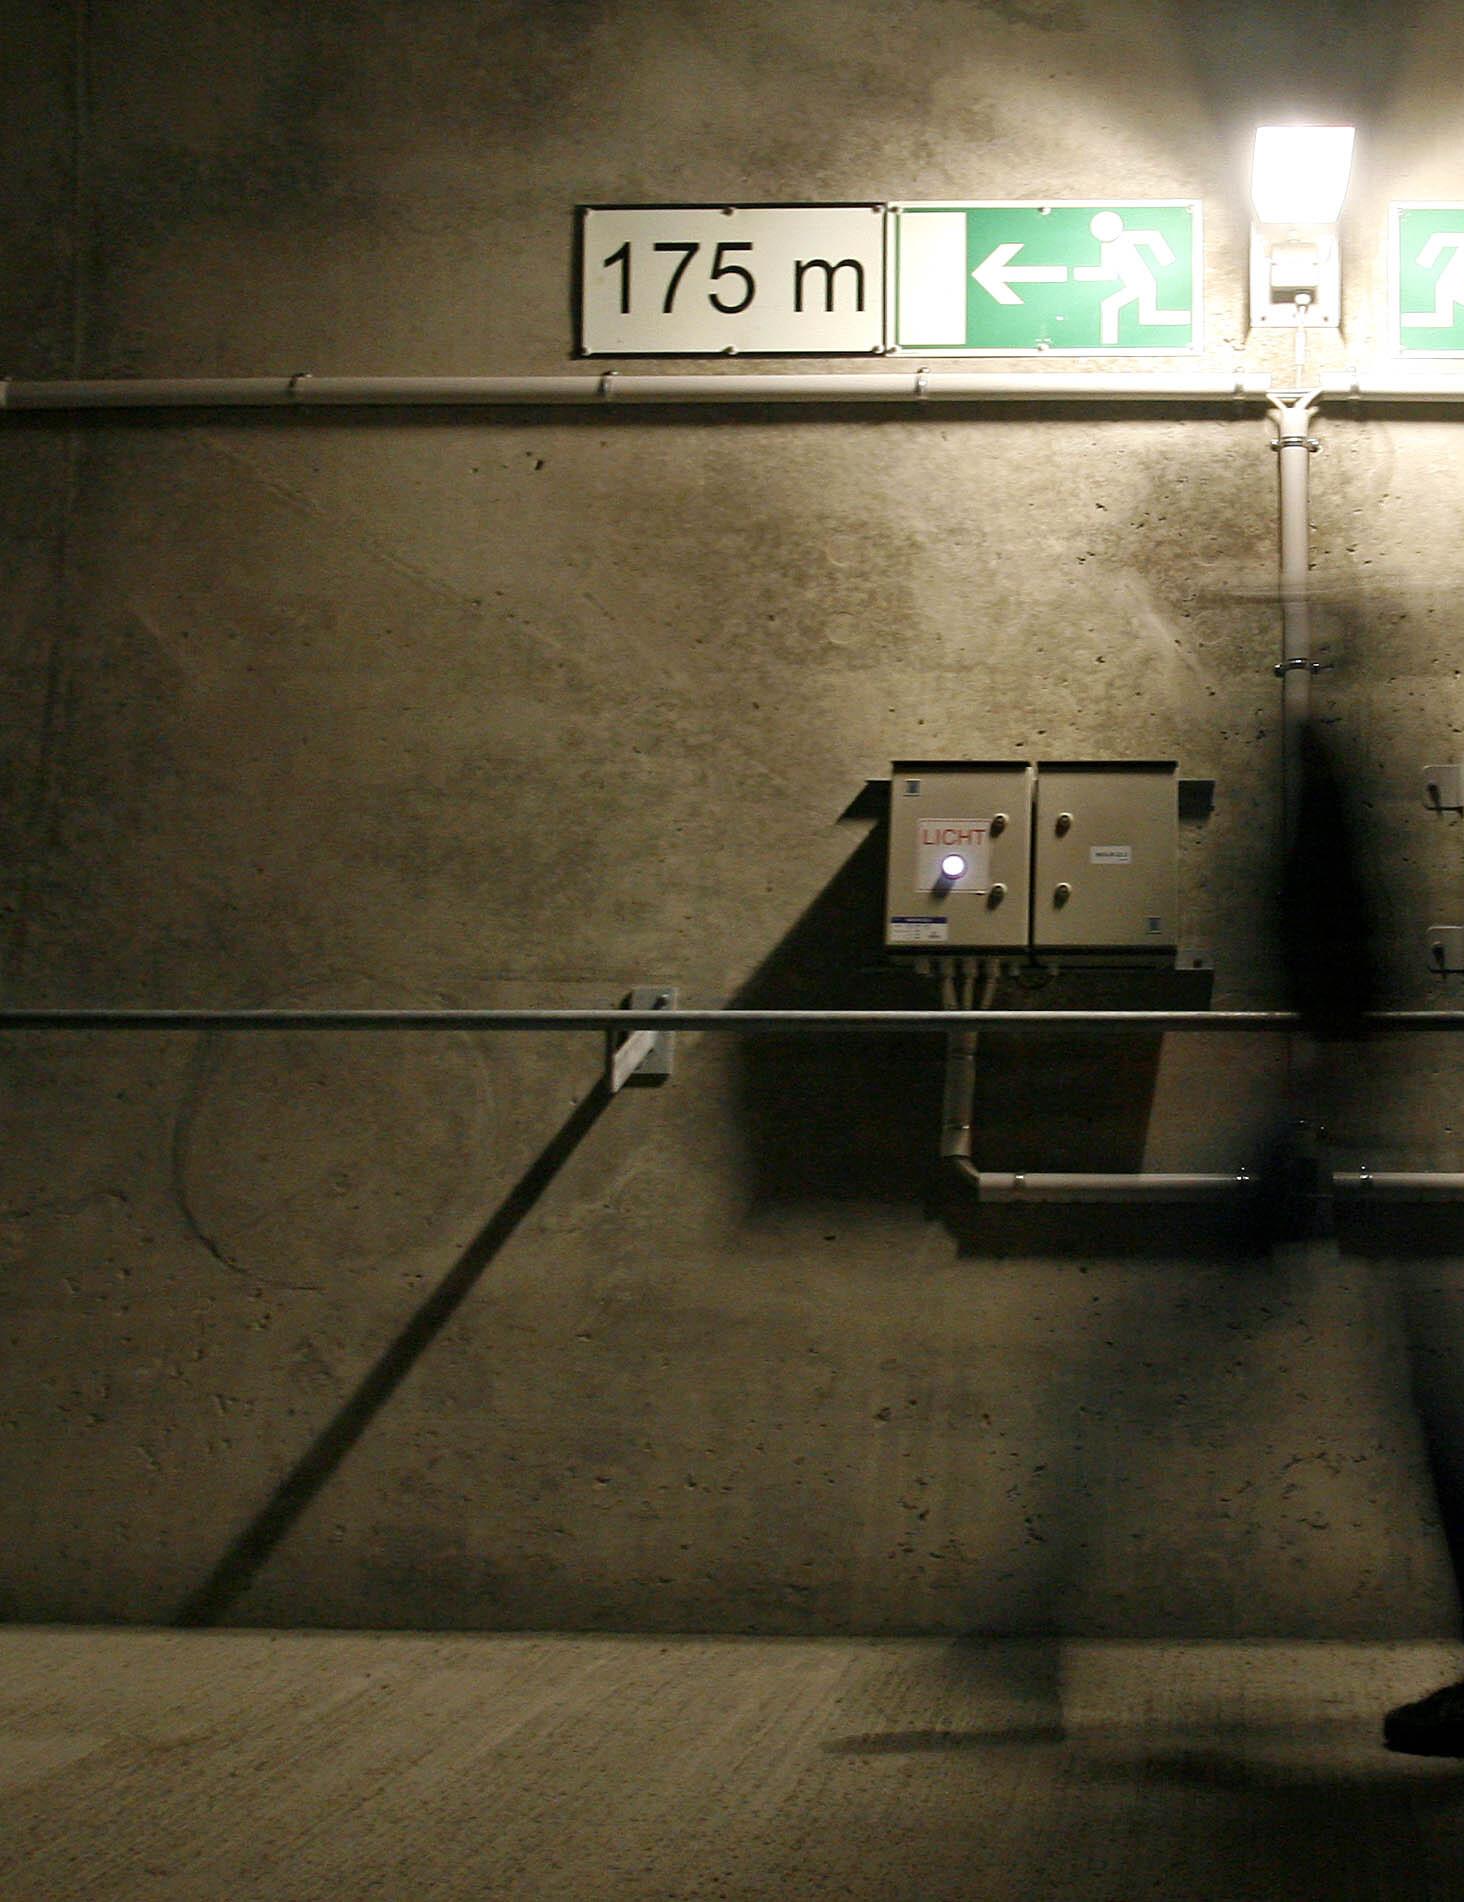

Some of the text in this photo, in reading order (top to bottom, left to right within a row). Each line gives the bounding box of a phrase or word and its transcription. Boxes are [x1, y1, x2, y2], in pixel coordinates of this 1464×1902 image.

[603, 241, 865, 315] 175 m
[922, 829, 986, 846] LICHT
